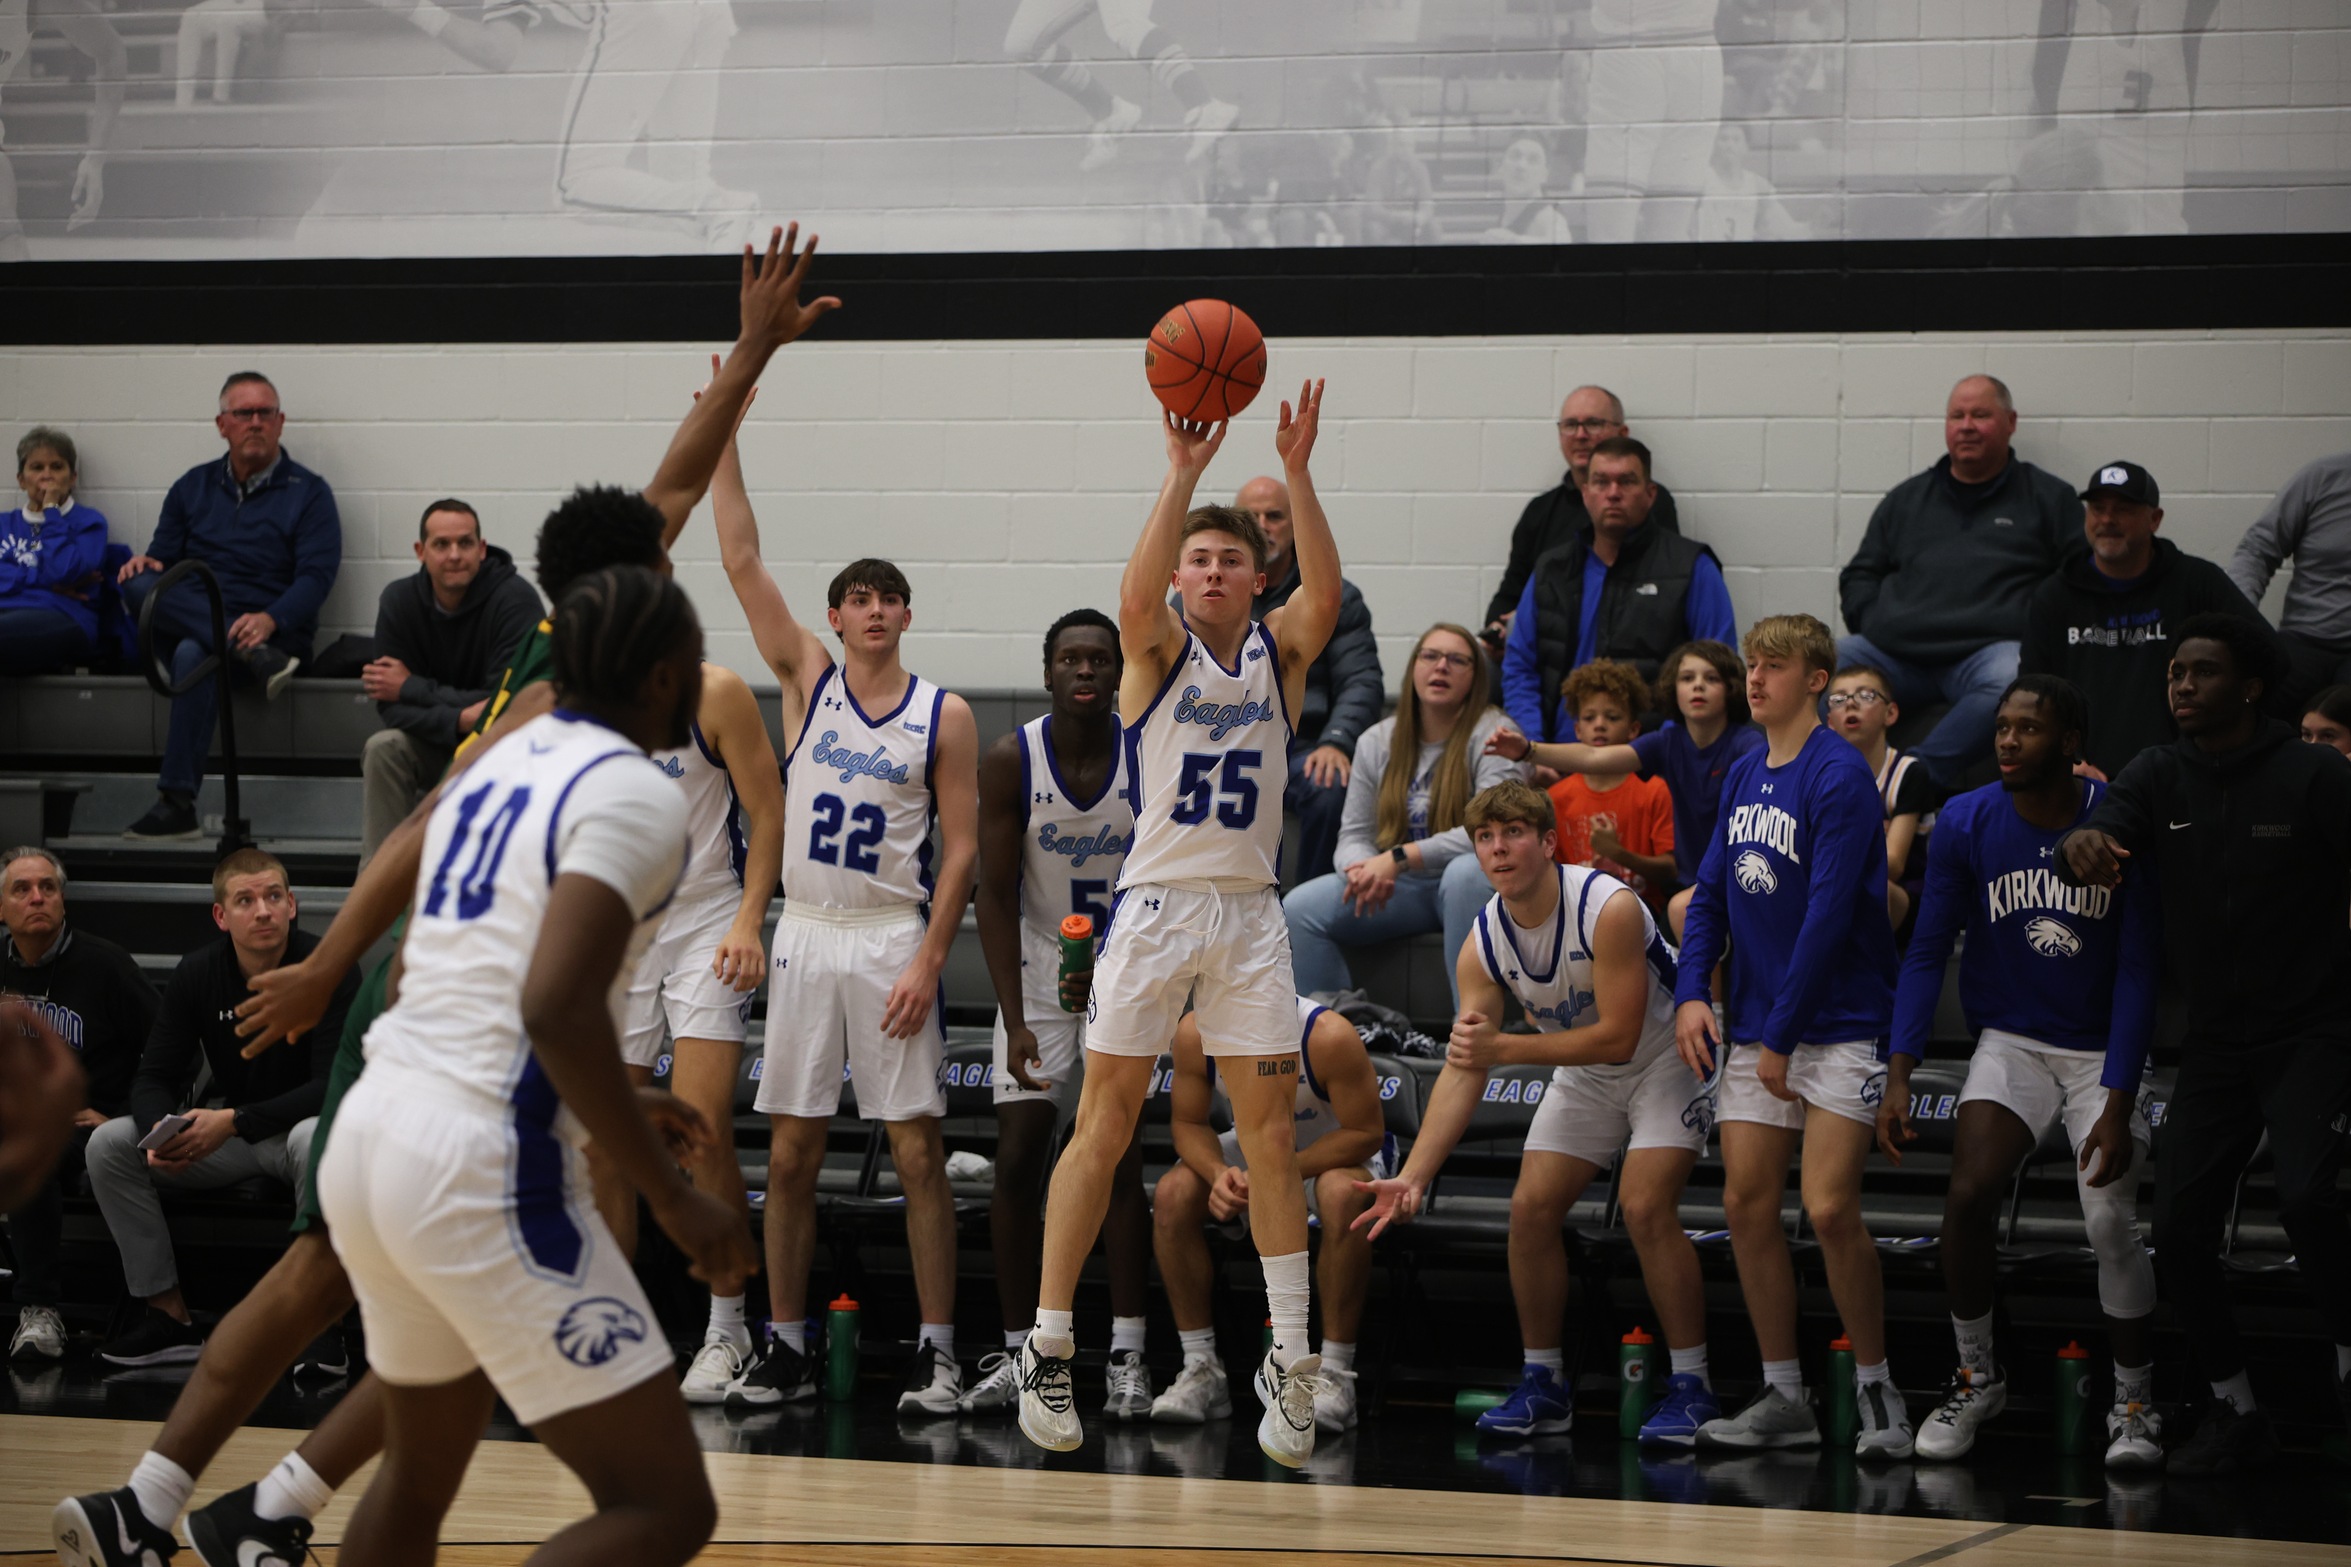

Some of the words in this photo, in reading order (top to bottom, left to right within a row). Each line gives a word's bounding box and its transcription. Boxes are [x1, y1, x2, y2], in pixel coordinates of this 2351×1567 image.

[1173, 685, 1274, 741] Eagles
[811, 730, 910, 785] Eagles
[1169, 749, 1263, 831] 55
[422, 780, 532, 921] 10
[807, 791, 888, 876] 22
[1987, 868, 2112, 924] KIRKWOOD
[1257, 1060, 1278, 1076] FEAR
[1280, 1059, 1296, 1075] GOD
